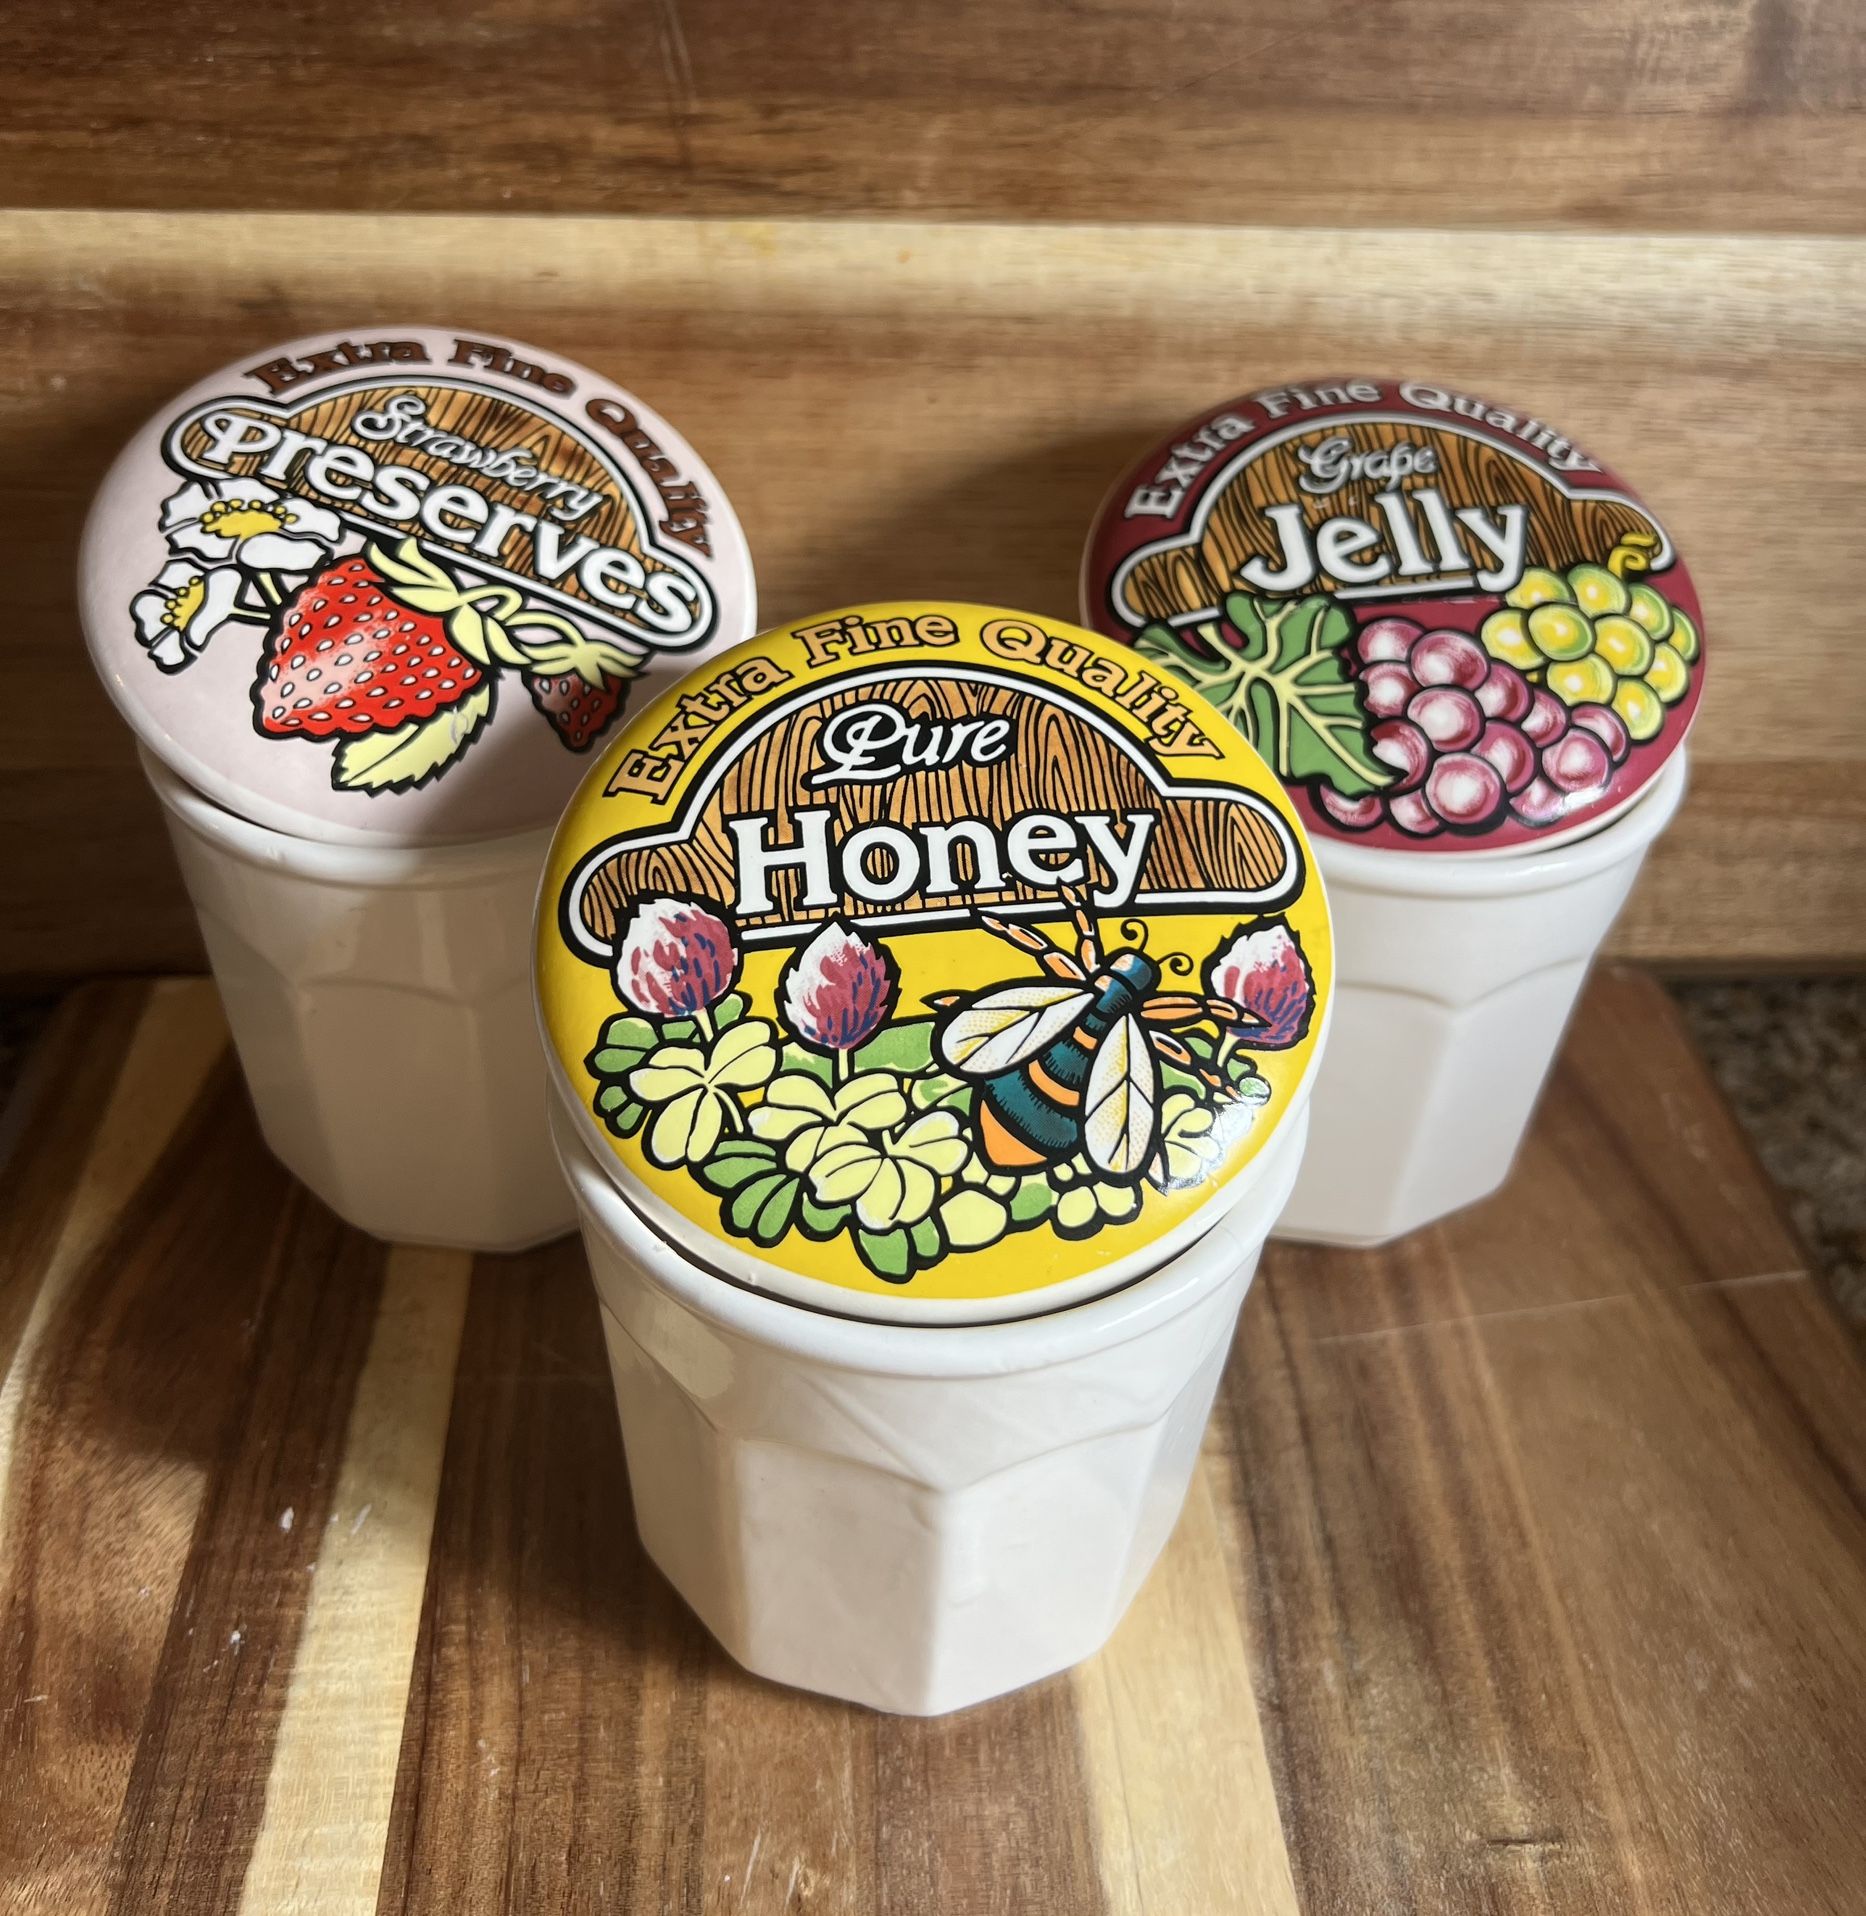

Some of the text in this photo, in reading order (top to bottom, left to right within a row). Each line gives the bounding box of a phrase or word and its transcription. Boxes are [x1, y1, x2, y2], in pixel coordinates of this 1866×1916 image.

[244, 338, 715, 559] Extra Fine Quality
[350, 393, 604, 520] Strawberry
[1124, 381, 1604, 520] Extra Fine Quality
[1298, 437, 1437, 495] Grape
[200, 413, 696, 635] Preserves
[1239, 488, 1529, 593] Jelly
[602, 614, 1225, 803] Extra Fine Quality
[810, 704, 1012, 785] Pure
[729, 808, 1157, 912] Honey
